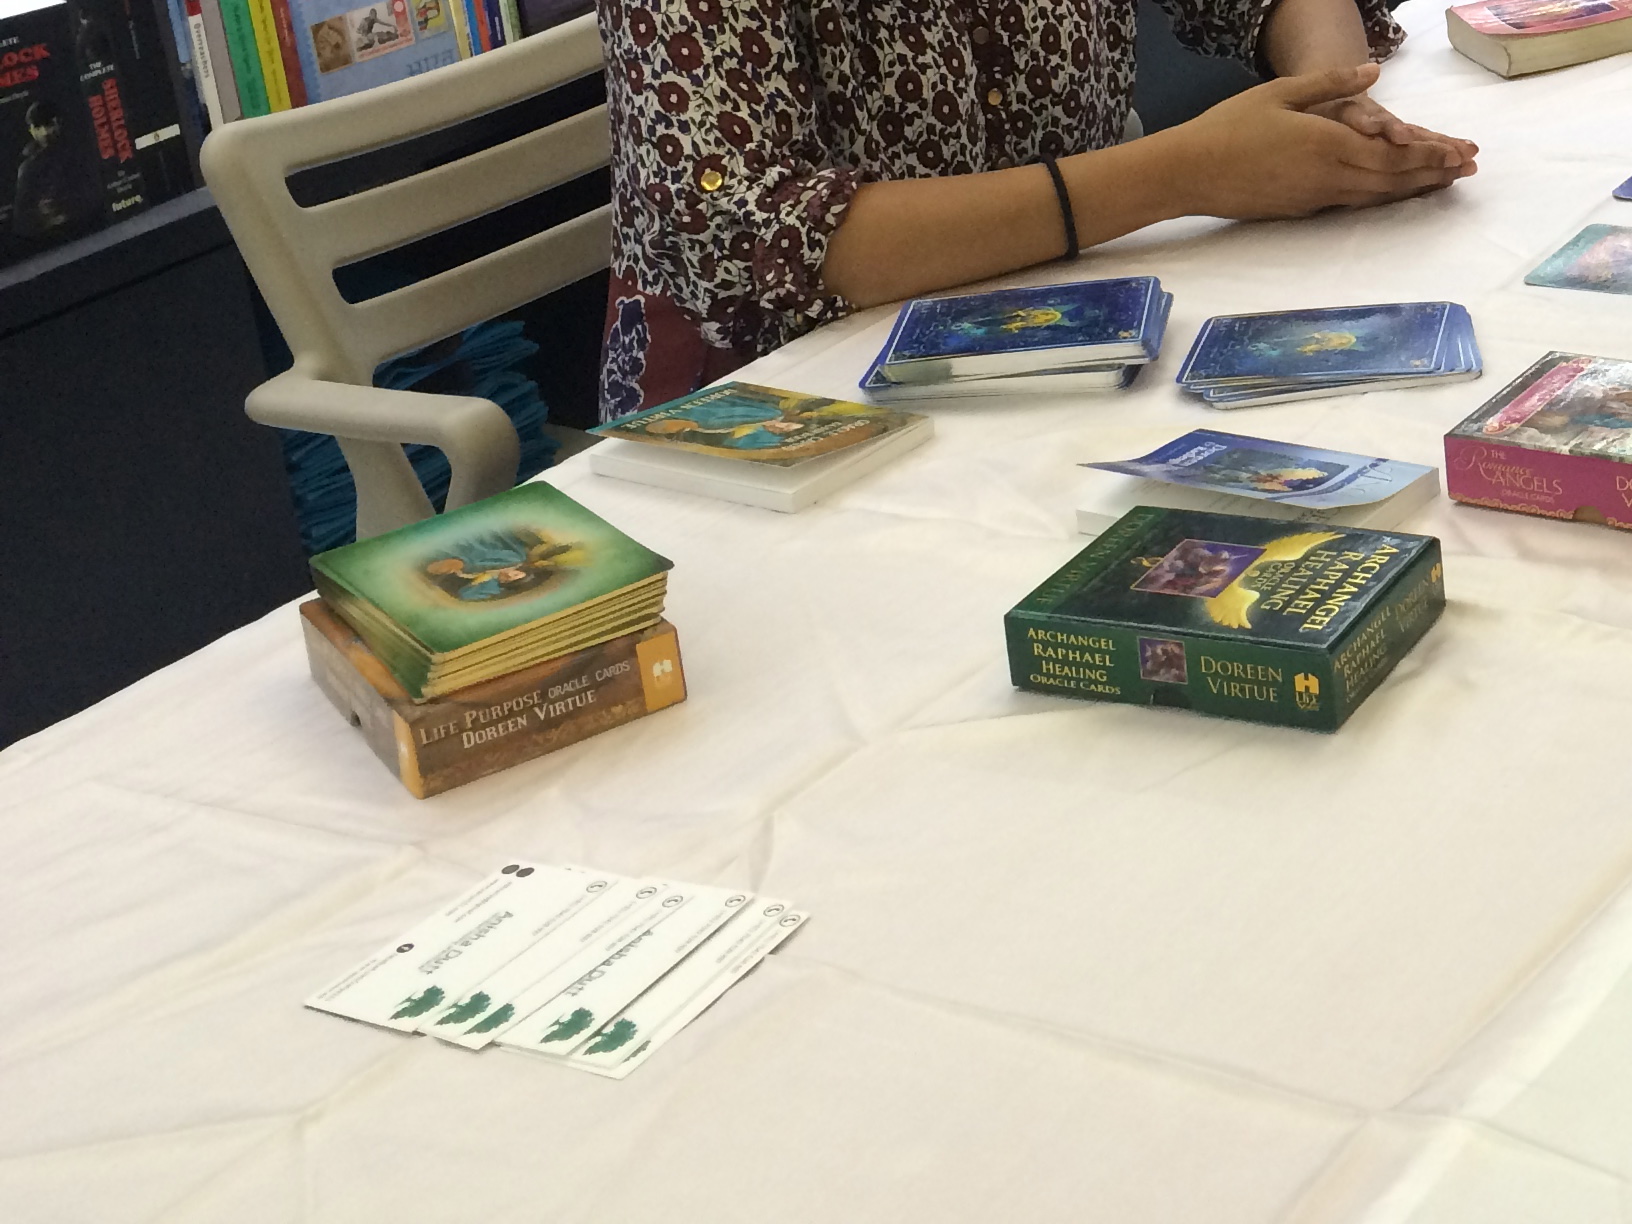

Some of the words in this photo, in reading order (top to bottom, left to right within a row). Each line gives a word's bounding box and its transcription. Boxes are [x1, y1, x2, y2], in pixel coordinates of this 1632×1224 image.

[88, 94, 115, 160] HOLMES
[101, 78, 134, 164] SHERLOCK
[1491, 475, 1563, 496] ANGELS
[1261, 550, 1337, 610] HEALING
[1283, 551, 1365, 616] RAPHAEL
[1299, 543, 1400, 632] ARCHANGEL
[1028, 627, 1116, 651] ARCHANGEL
[1033, 643, 1115, 667] RAPHAEL
[1030, 673, 1077, 688] ORACLE
[1080, 680, 1121, 695] CARDS
[1042, 660, 1107, 682] HEALING
[1201, 655, 1282, 683] DOREEN
[1206, 676, 1278, 702] VIRTUE
[419, 719, 459, 745] LIFE
[464, 690, 543, 728] PURPOSE
[548, 675, 590, 699] ORACLE
[595, 659, 631, 680] CARDS
[462, 713, 528, 749] DOREEN
[532, 689, 597, 721] VIRTUE
